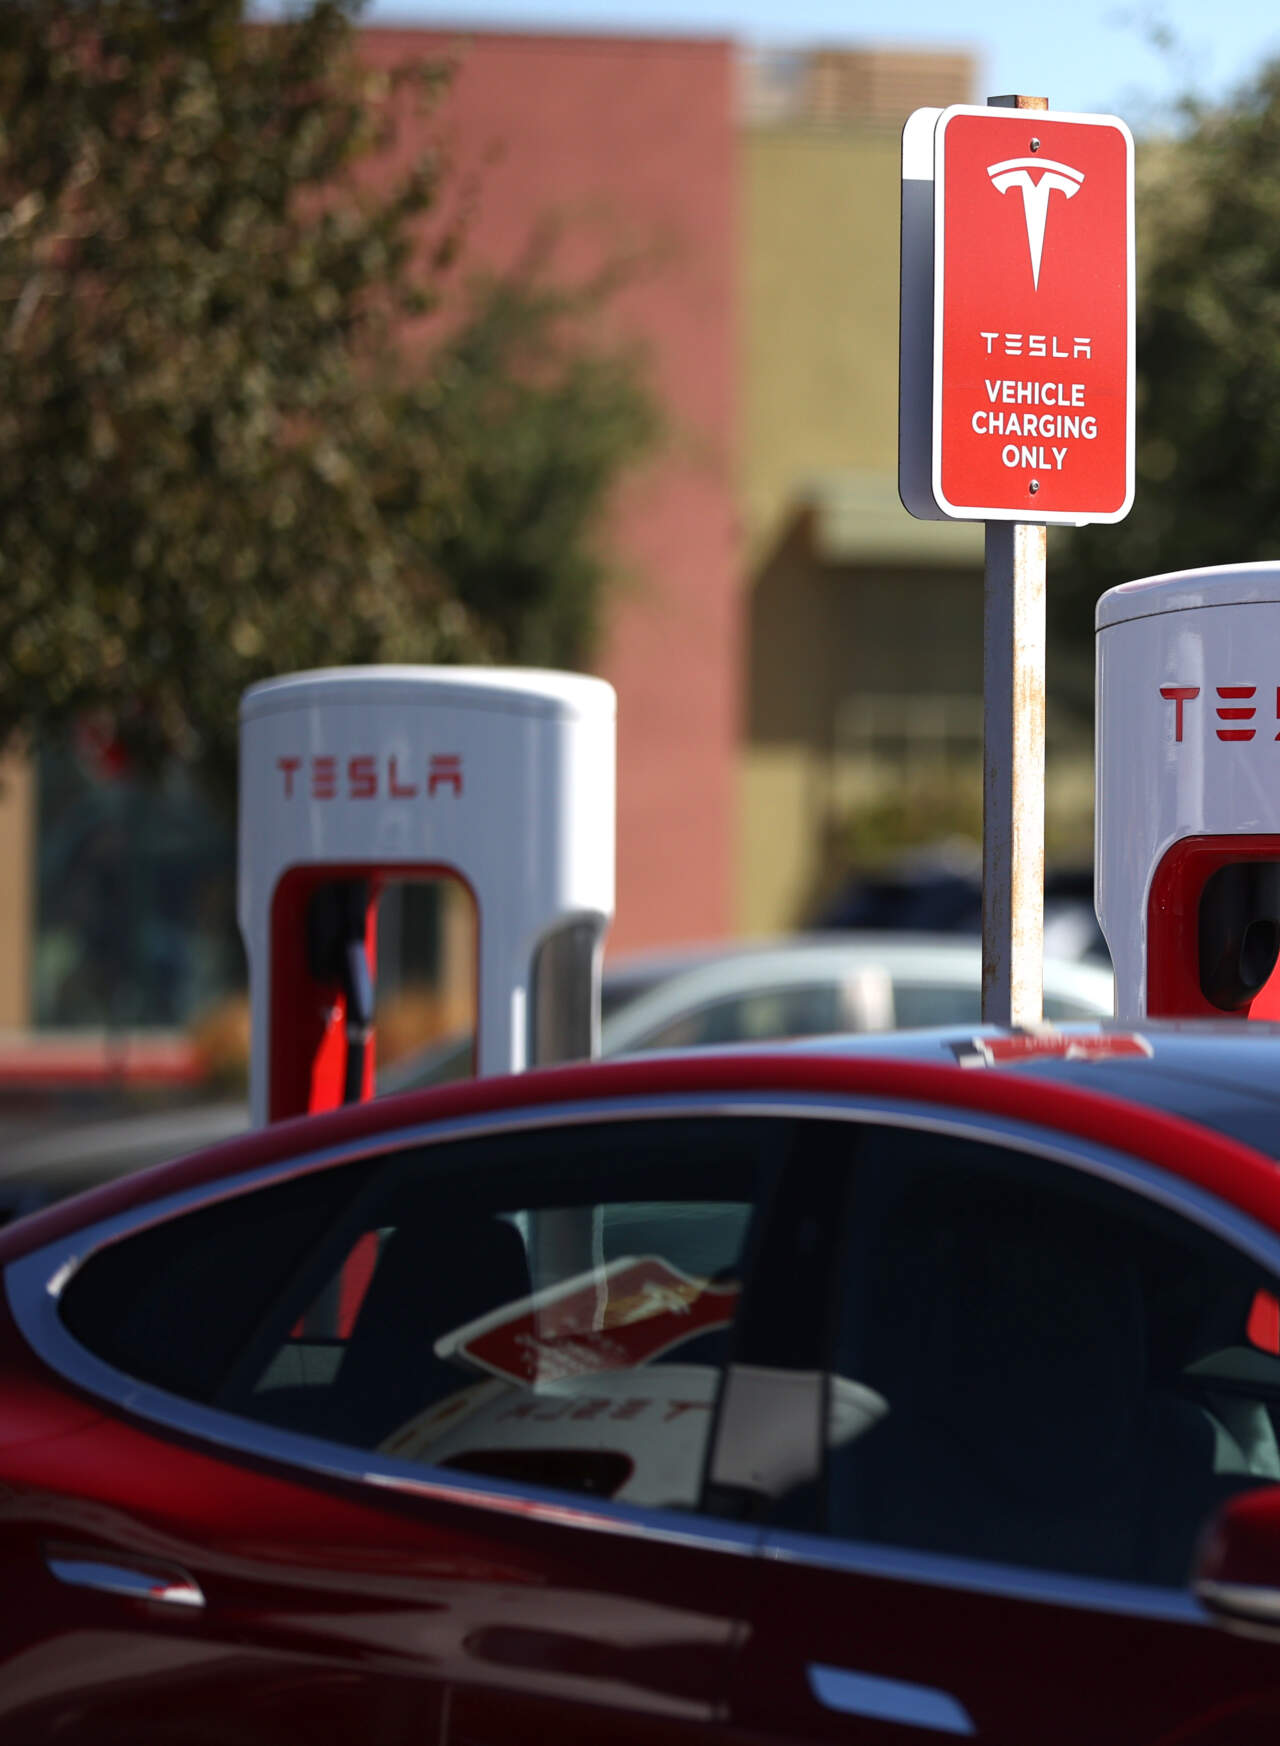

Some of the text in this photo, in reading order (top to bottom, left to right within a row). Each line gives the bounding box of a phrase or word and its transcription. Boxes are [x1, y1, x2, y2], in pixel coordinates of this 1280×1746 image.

[980, 332, 1092, 359] TESLA
[985, 380, 1085, 407] VEHICLE
[971, 411, 1098, 439] CHARGING
[1001, 444, 1068, 470] ONLY
[276, 754, 464, 800] TESLA
